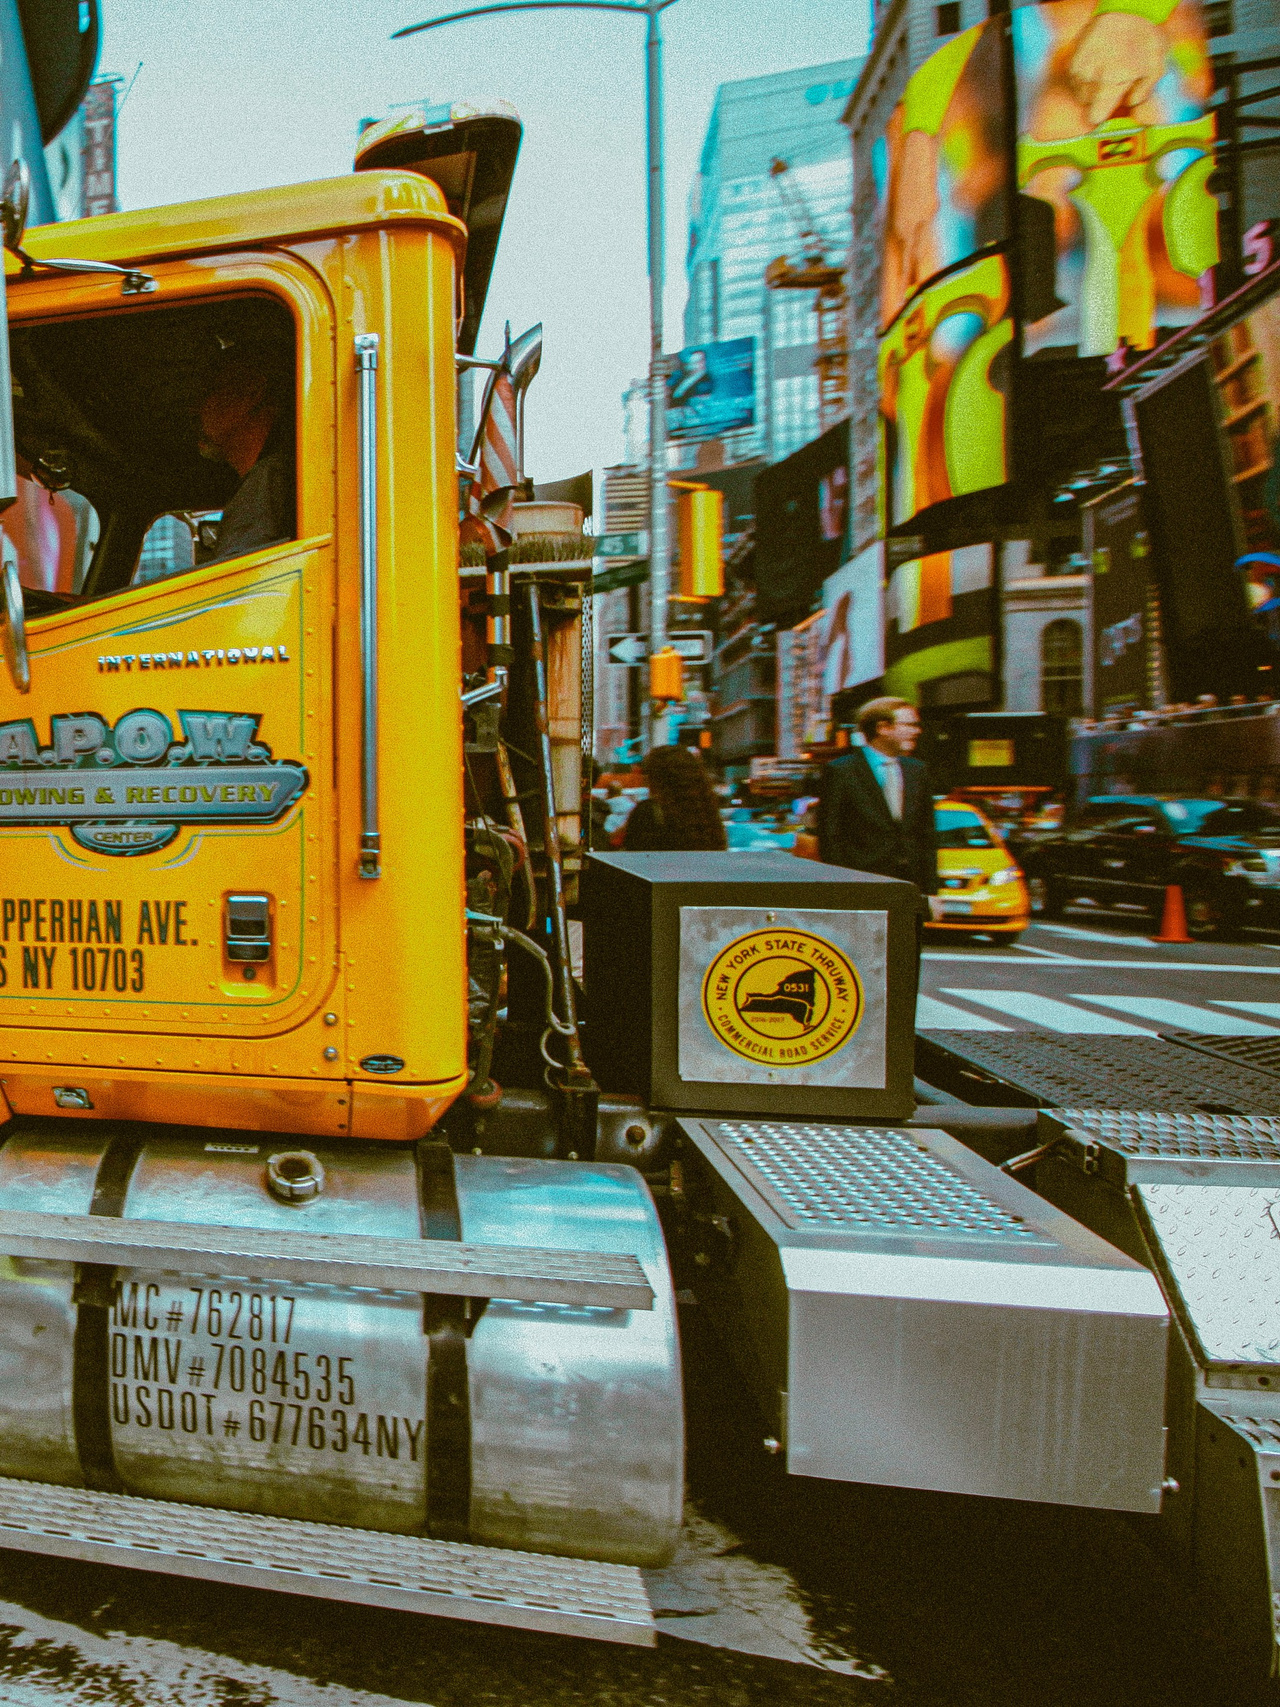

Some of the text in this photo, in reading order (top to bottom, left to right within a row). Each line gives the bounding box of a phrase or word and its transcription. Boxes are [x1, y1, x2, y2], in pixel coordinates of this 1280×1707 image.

[97, 645, 290, 673] INTERNATIONAL
[94, 785, 115, 805] &
[126, 781, 280, 805] RECOVERY
[92, 829, 155, 843] CENTER
[136, 899, 199, 946] AVE.
[22, 945, 58, 989] NY
[69, 946, 145, 993] 10703
[716, 939, 850, 1002] NEW YORK STATE THRUWAY
[783, 983, 810, 993] 0531
[717, 1013, 846, 1059] COMMERCIAL ROAD SERVICE
